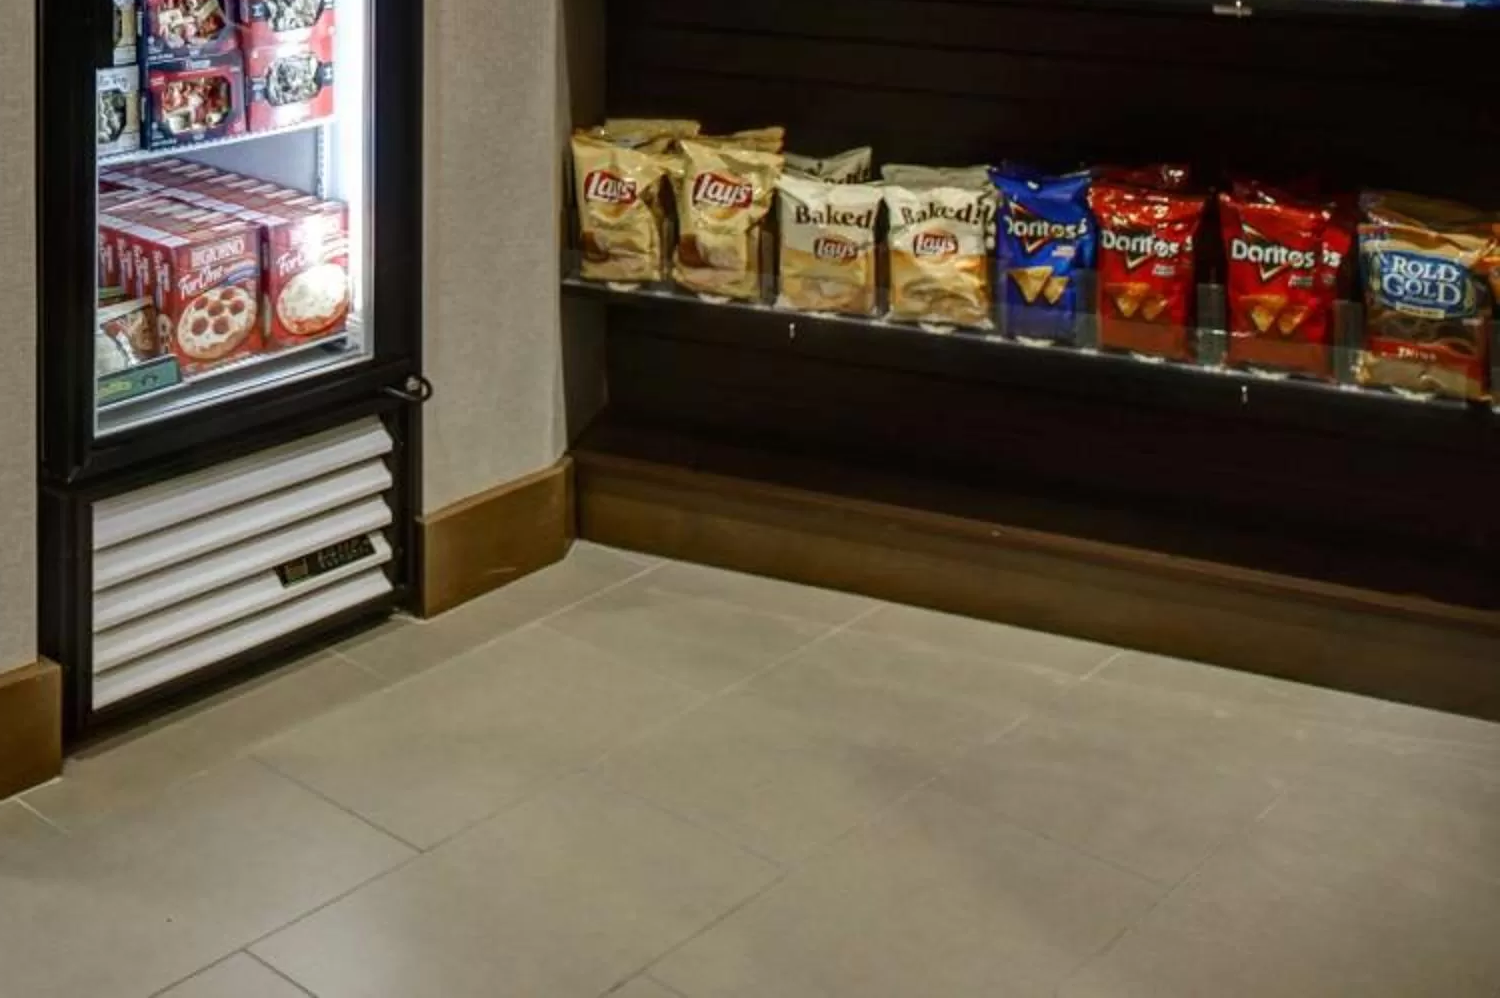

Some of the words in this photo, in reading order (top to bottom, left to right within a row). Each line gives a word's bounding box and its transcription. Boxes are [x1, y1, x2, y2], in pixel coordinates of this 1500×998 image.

[1101, 230, 1179, 258] Doritos
[1231, 239, 1315, 270] Doritos
[1391, 256, 1460, 283] ROLD
[1382, 274, 1461, 304] GOLD
